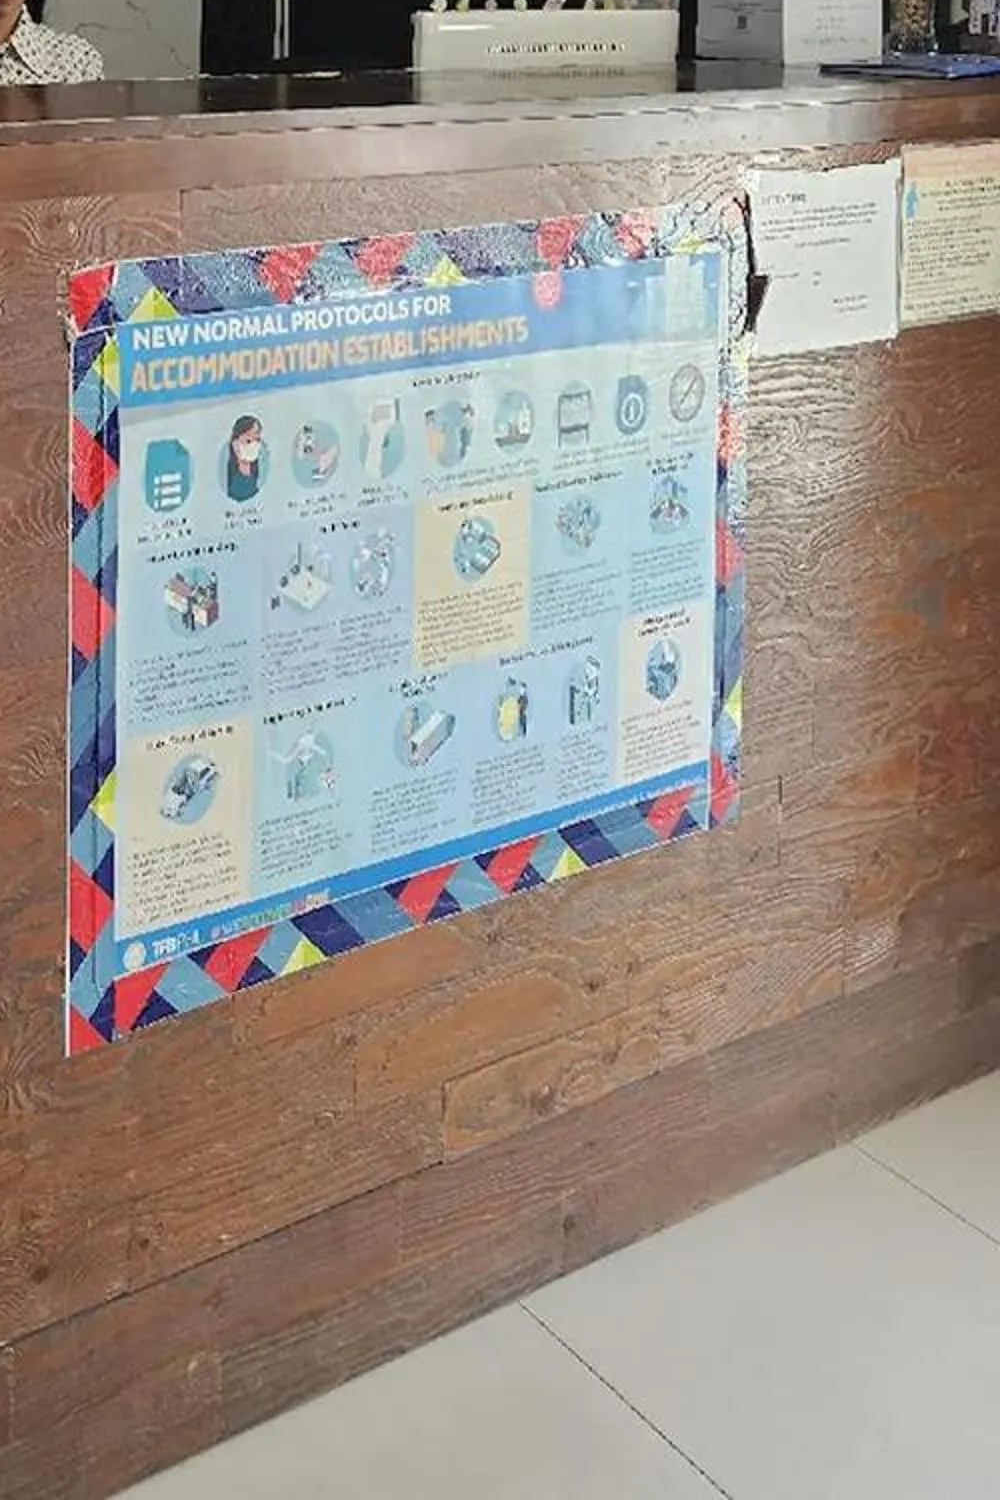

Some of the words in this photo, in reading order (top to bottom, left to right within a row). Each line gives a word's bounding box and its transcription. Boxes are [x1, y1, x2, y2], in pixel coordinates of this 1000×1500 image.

[131, 337, 340, 393] ACCOMMODATION
[344, 315, 529, 364] ESTABLISHMENTS
[132, 324, 187, 351] NEW
[193, 314, 289, 343] NORMAL
[291, 300, 409, 334] PROTOCOLS
[412, 295, 452, 317] FOR
